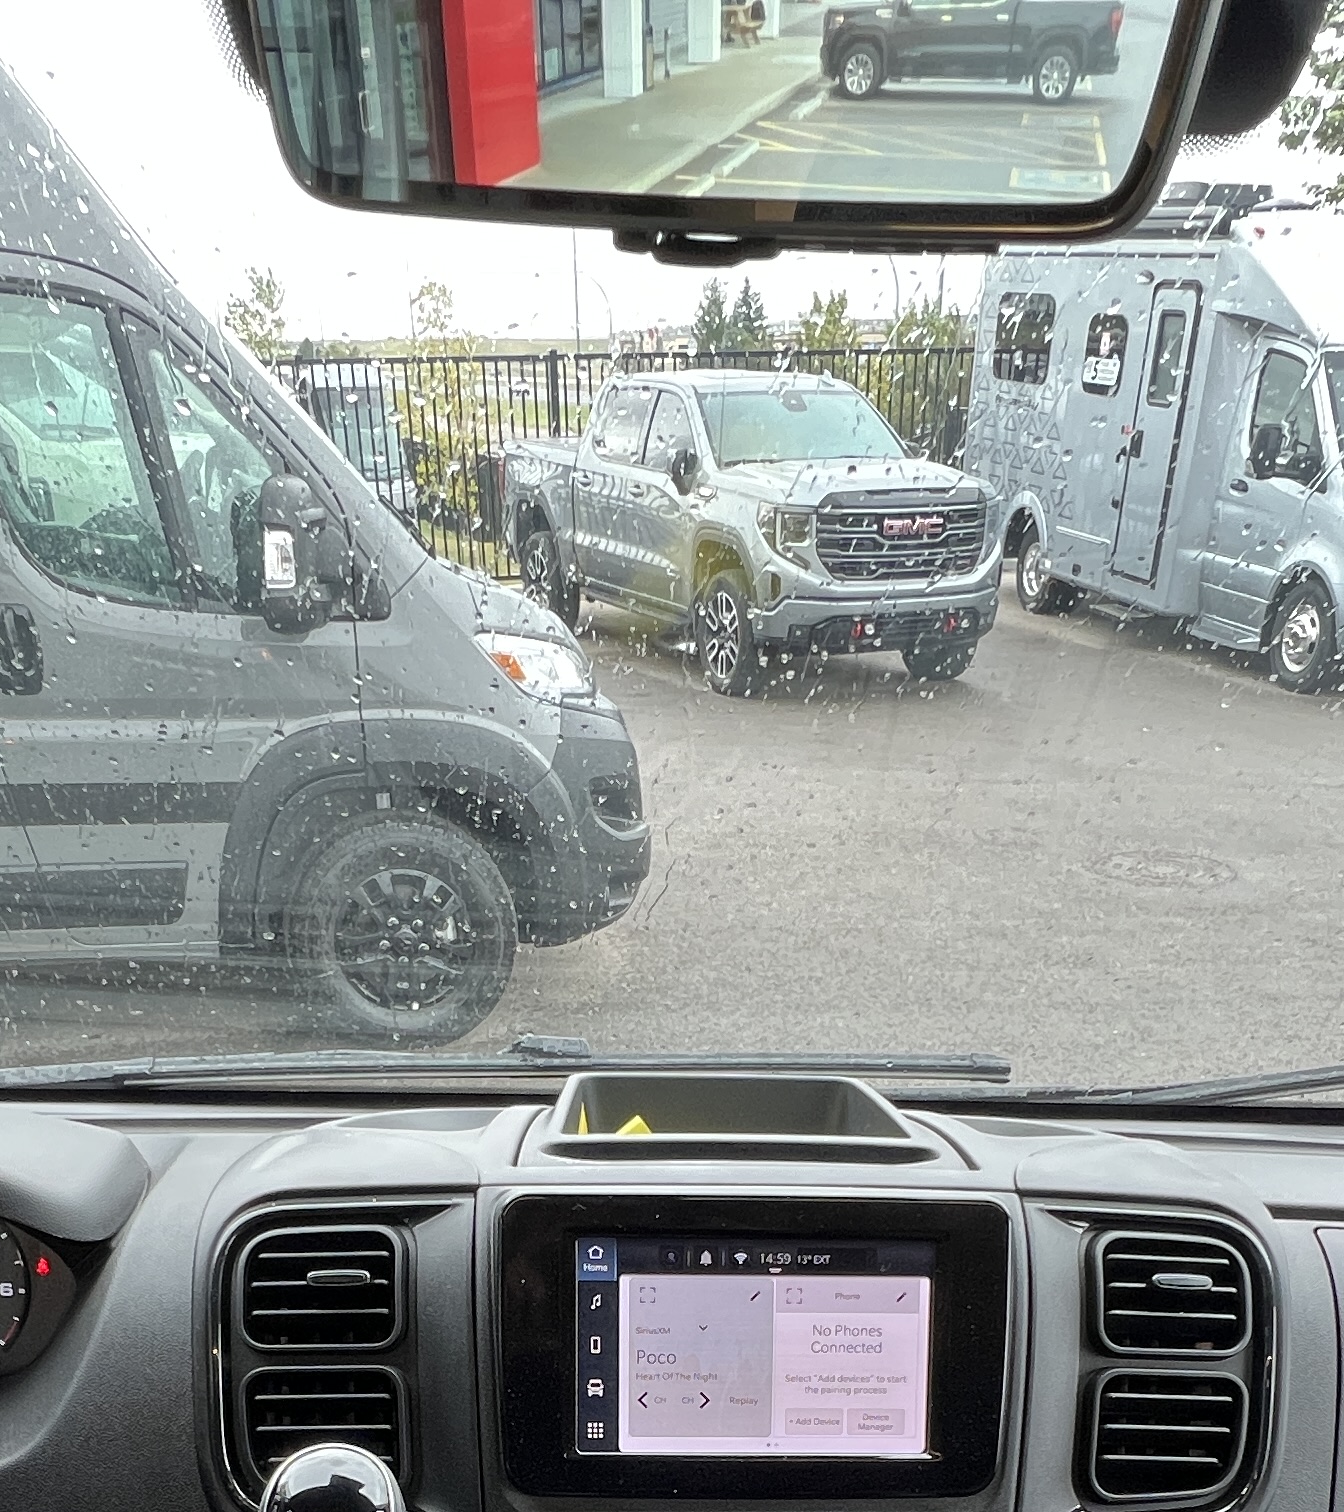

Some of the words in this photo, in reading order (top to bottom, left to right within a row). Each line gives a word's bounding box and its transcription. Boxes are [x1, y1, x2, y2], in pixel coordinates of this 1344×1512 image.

[883, 517, 944, 536] GMC
[759, 1252, 792, 1265] 14:59
[813, 1254, 831, 1265] EXT
[582, 1262, 609, 1273] Home
[834, 1292, 861, 1301] Phone
[635, 1326, 671, 1335] SiriusXM
[812, 1324, 832, 1338] No
[834, 1323, 883, 1338] Phones
[810, 1340, 883, 1354] Connected
[636, 1349, 677, 1365] Poco
[635, 1372, 661, 1381] Heart
[662, 1372, 675, 1381] Of
[675, 1372, 691, 1381] The
[694, 1372, 718, 1383] Night
[784, 1374, 812, 1383] Select
[886, 1375, 907, 1383] start
[804, 1385, 819, 1395] the
[820, 1385, 851, 1396] pairing
[853, 1386, 887, 1396] process
[729, 1396, 758, 1406] Replay
[795, 1417, 811, 1426] Add
[813, 1417, 840, 1426] Device
[862, 1412, 890, 1422] Device
[857, 1422, 893, 1432] Manager
